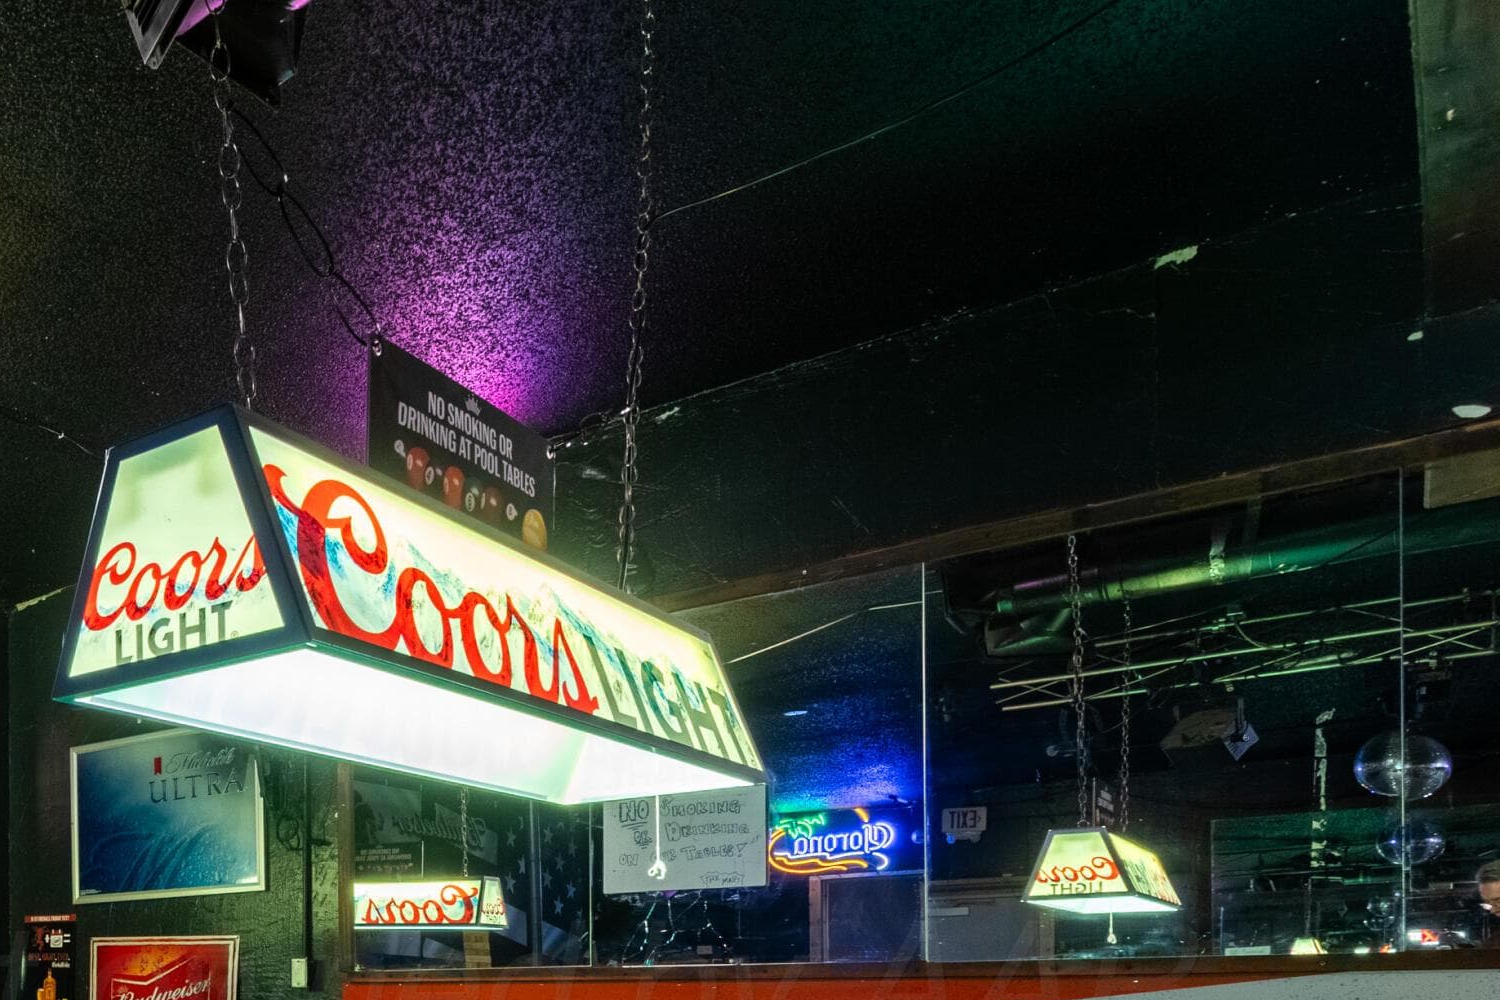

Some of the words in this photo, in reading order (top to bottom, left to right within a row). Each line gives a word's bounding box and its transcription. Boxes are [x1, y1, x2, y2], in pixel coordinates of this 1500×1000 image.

[398, 401, 457, 453] DRINKING
[458, 436, 473, 460] AT
[474, 443, 501, 478] POOL
[502, 460, 536, 498] TABLES
[428, 391, 446, 420] NO
[447, 403, 498, 450] SMOKING
[499, 434, 513, 460] OR
[84, 531, 268, 631] Coors
[262, 462, 601, 716] Coors
[114, 600, 235, 666] LIGHT
[588, 639, 758, 773] LIGHT
[149, 768, 247, 803] ULTRA
[619, 799, 649, 822] NO
[660, 798, 741, 816] SMOKING
[619, 853, 639, 866] ON
[634, 829, 652, 843] OR
[665, 821, 750, 842] DRINKING
